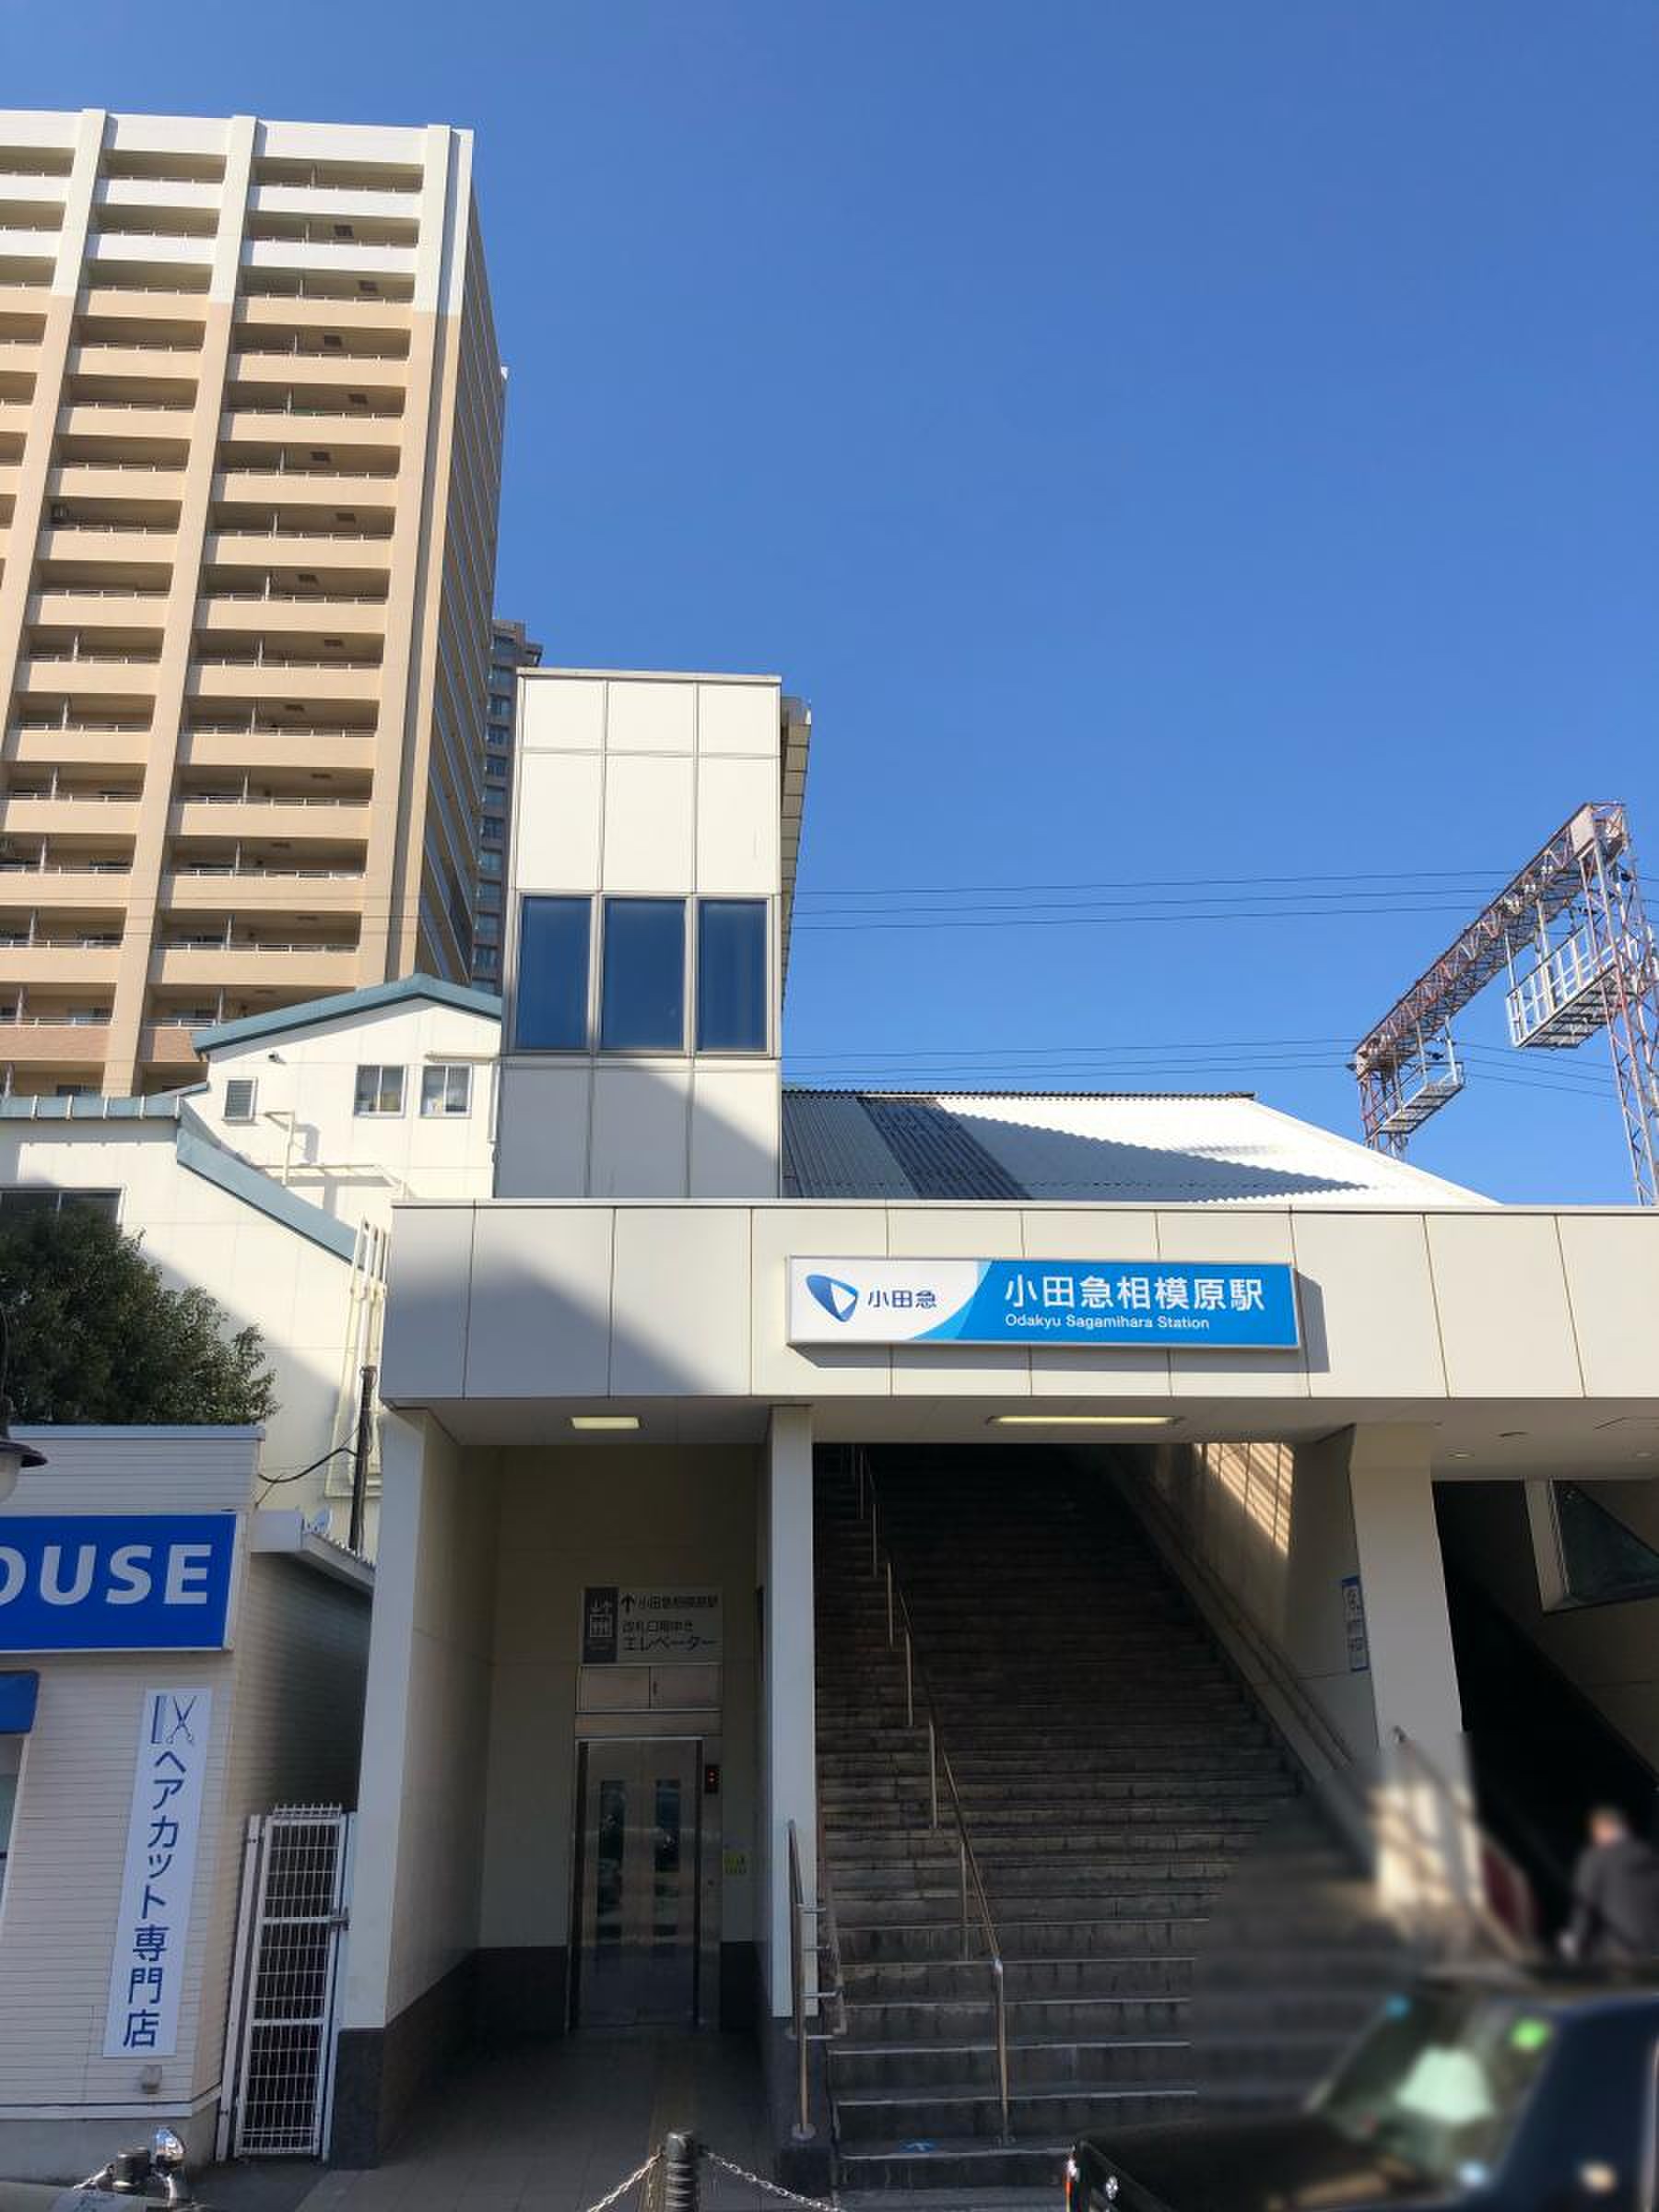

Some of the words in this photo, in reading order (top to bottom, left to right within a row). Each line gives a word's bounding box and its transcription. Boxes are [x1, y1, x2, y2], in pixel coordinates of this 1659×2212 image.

[867, 1289, 937, 1310] 小田急
[1005, 1275, 1265, 1312] 小田急相模原駅
[1006, 1313, 1061, 1331] Odakyu
[1065, 1314, 1153, 1330] Sagamihara
[1157, 1316, 1210, 1329] Station
[123, 1750, 187, 2049] ヘアカット専門店
